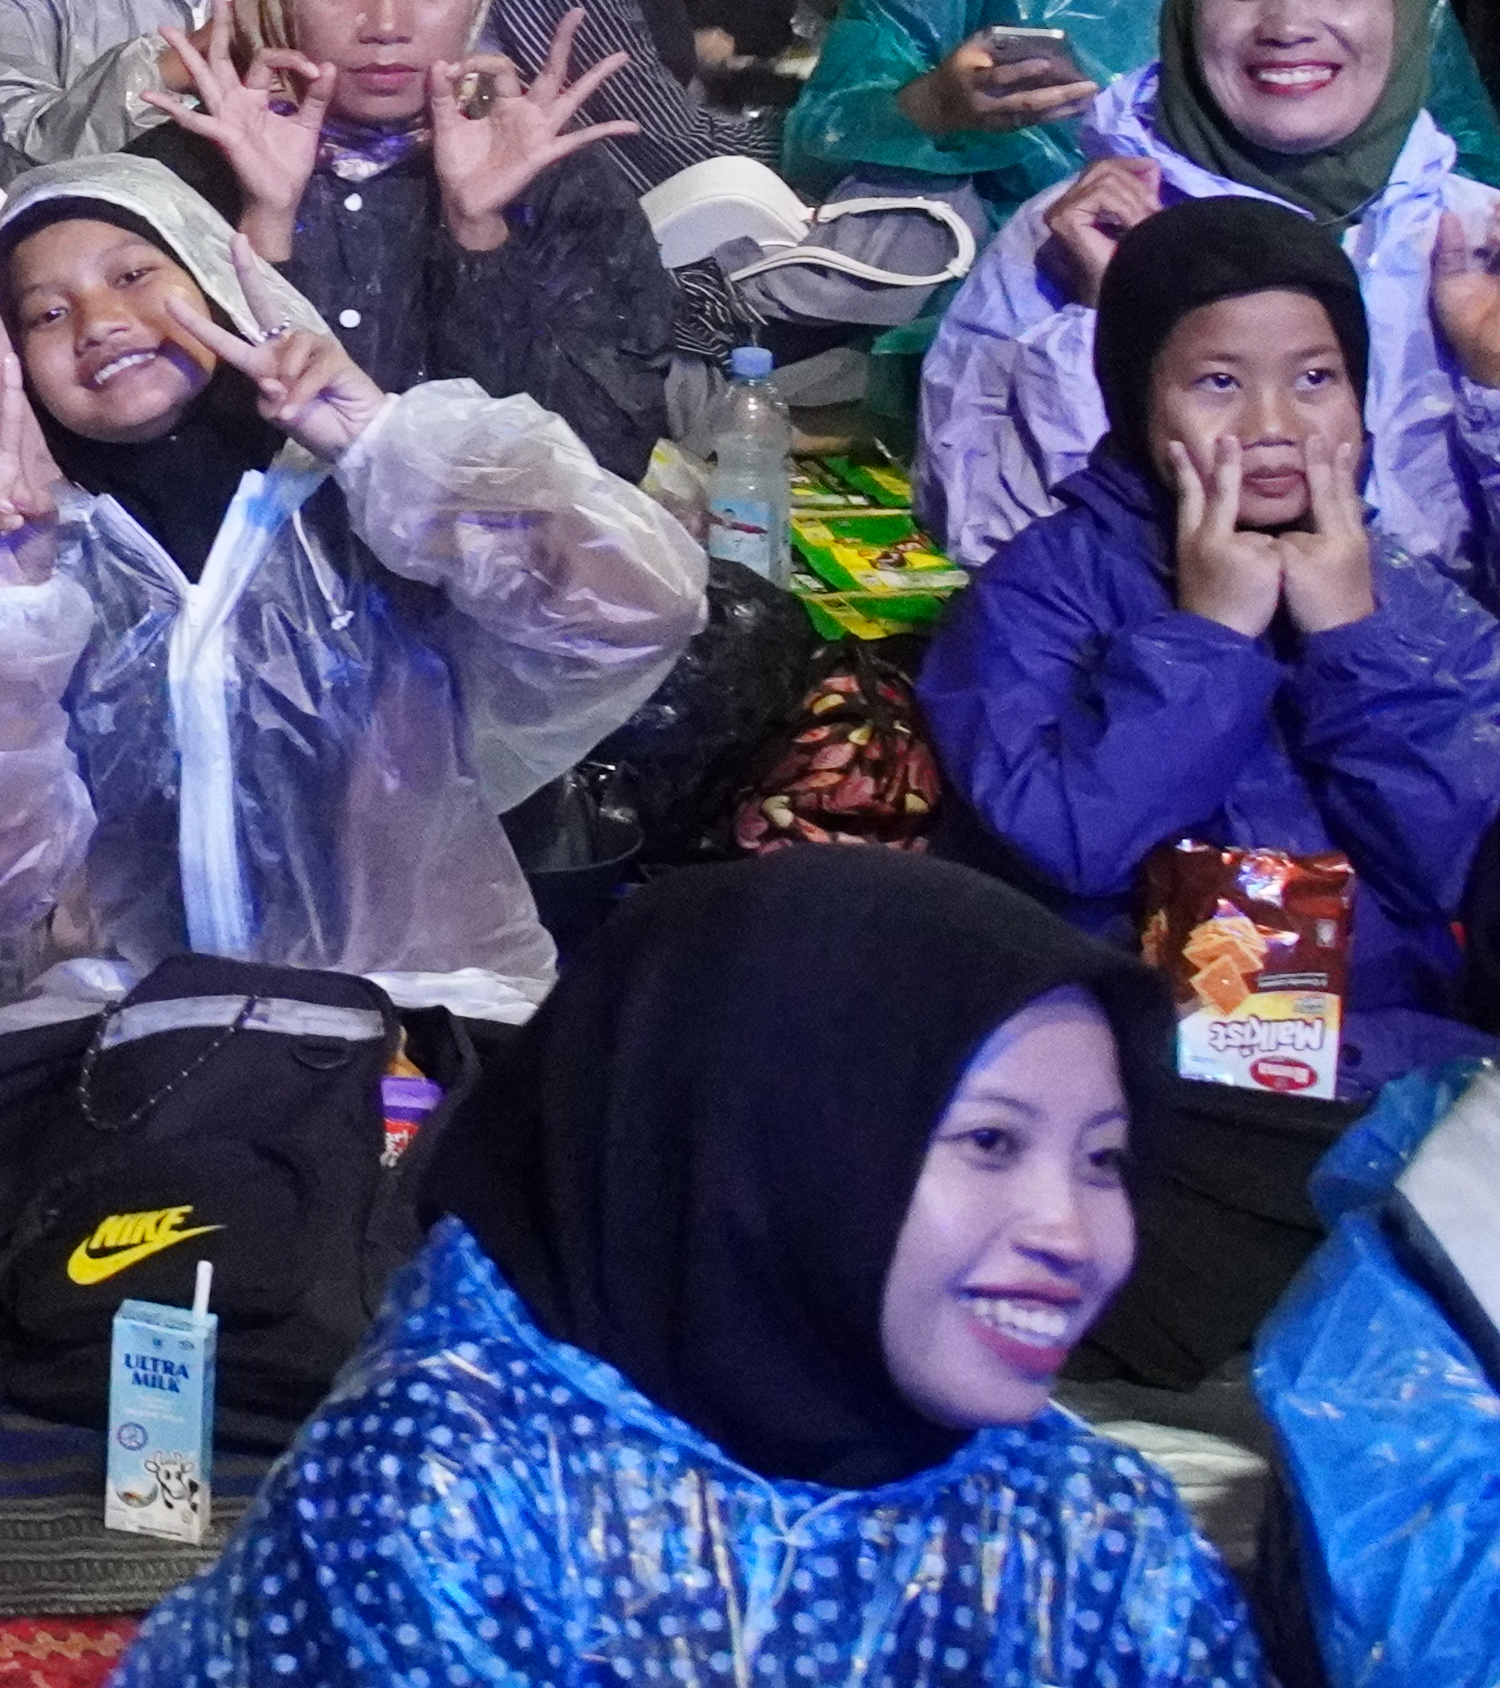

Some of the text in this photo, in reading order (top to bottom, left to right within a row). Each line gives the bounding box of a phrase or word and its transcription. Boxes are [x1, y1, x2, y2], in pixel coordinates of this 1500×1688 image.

[1207, 1015, 1325, 1059] Malkist
[89, 1205, 193, 1249] NIKE
[124, 1353, 190, 1380] ULTRA
[131, 1371, 180, 1394] MILK
